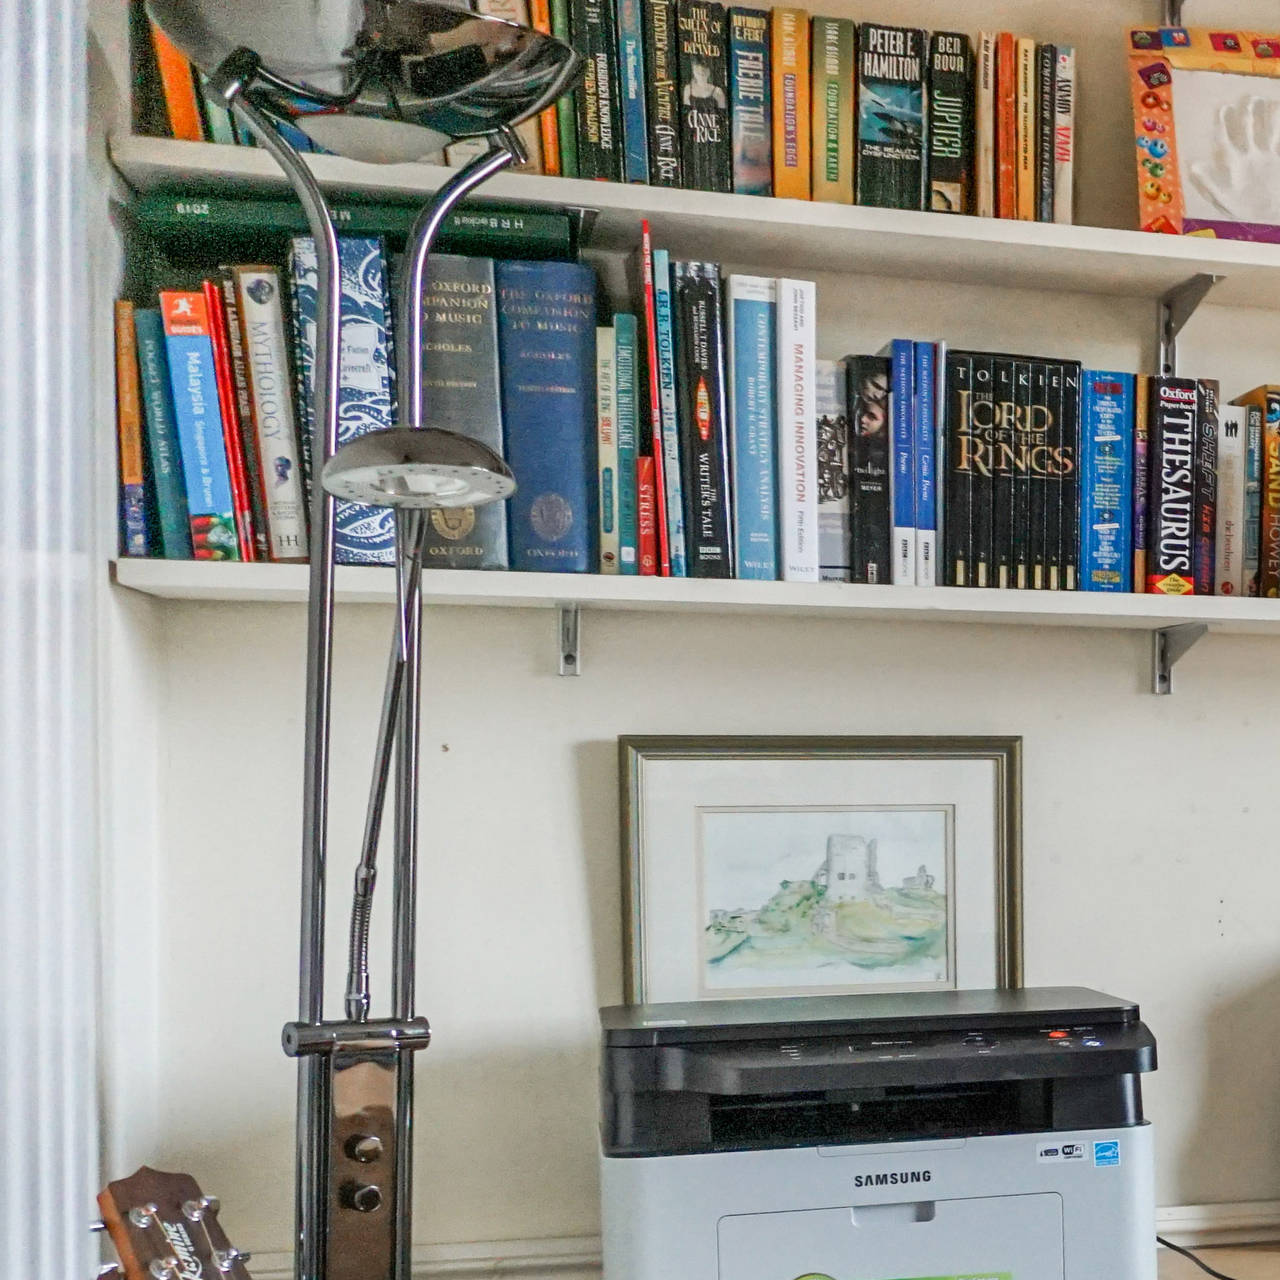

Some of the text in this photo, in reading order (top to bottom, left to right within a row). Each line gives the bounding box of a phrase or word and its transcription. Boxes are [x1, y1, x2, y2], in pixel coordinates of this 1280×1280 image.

[869, 28, 903, 52] PETER
[938, 37, 960, 53] BEN
[864, 52, 920, 81] HAMILTON
[934, 53, 963, 72] BOVA
[596, 53, 612, 149] FORBIDDEN KNOWLEDGE
[735, 50, 764, 141] FAERIE TALE
[1042, 52, 1052, 120] TOMORROW
[1057, 76, 1073, 116] ASIMOV
[587, 96, 599, 142] DONALDSON
[688, 110, 719, 130] ANNE
[693, 126, 721, 143] RICE
[783, 74, 799, 167] FOUNDATION'S EDGE
[826, 84, 840, 182] FOUNDATION EARTH
[932, 89, 962, 158] JUPITER
[862, 150, 920, 161] DYSFUNCTION
[432, 281, 492, 294] OXFORD
[533, 291, 593, 305] OXFORD
[436, 312, 482, 324] MUSIC
[502, 305, 590, 320] COMPANION
[537, 321, 582, 334] MUSIC
[657, 288, 672, 390] J.R.R. TOLKIEN
[697, 300, 709, 370] RUSSELL DAVIES
[250, 321, 281, 441] MYTHOLOGY
[618, 345, 634, 450] EMOTIONAL INTELLIGENCE
[957, 366, 1077, 388] TOLKIEN
[1159, 386, 1196, 402] Oxford
[149, 387, 171, 474] WORLD ATLAS
[186, 351, 206, 416] Malaysia
[196, 468, 213, 508] Brunei
[757, 313, 770, 521] CONTEMPORARY STRATEGY ANALYSIS
[792, 343, 807, 503] MANAGING INNOVATION
[957, 389, 1053, 433] LORD
[748, 426, 756, 455] GRANT
[955, 435, 1074, 476] RINGS
[1202, 422, 1216, 503] SHIFT
[640, 484, 651, 536] STRESS
[698, 453, 714, 538] WRITER'S TALE
[1159, 411, 1193, 572] THESAURUS
[430, 546, 484, 557] OXFORD
[527, 548, 579, 558] OXFORD
[743, 560, 773, 569] WILEY
[1267, 514, 1280, 578] HOWEY
[854, 1170, 932, 1187] SAMSUNG
